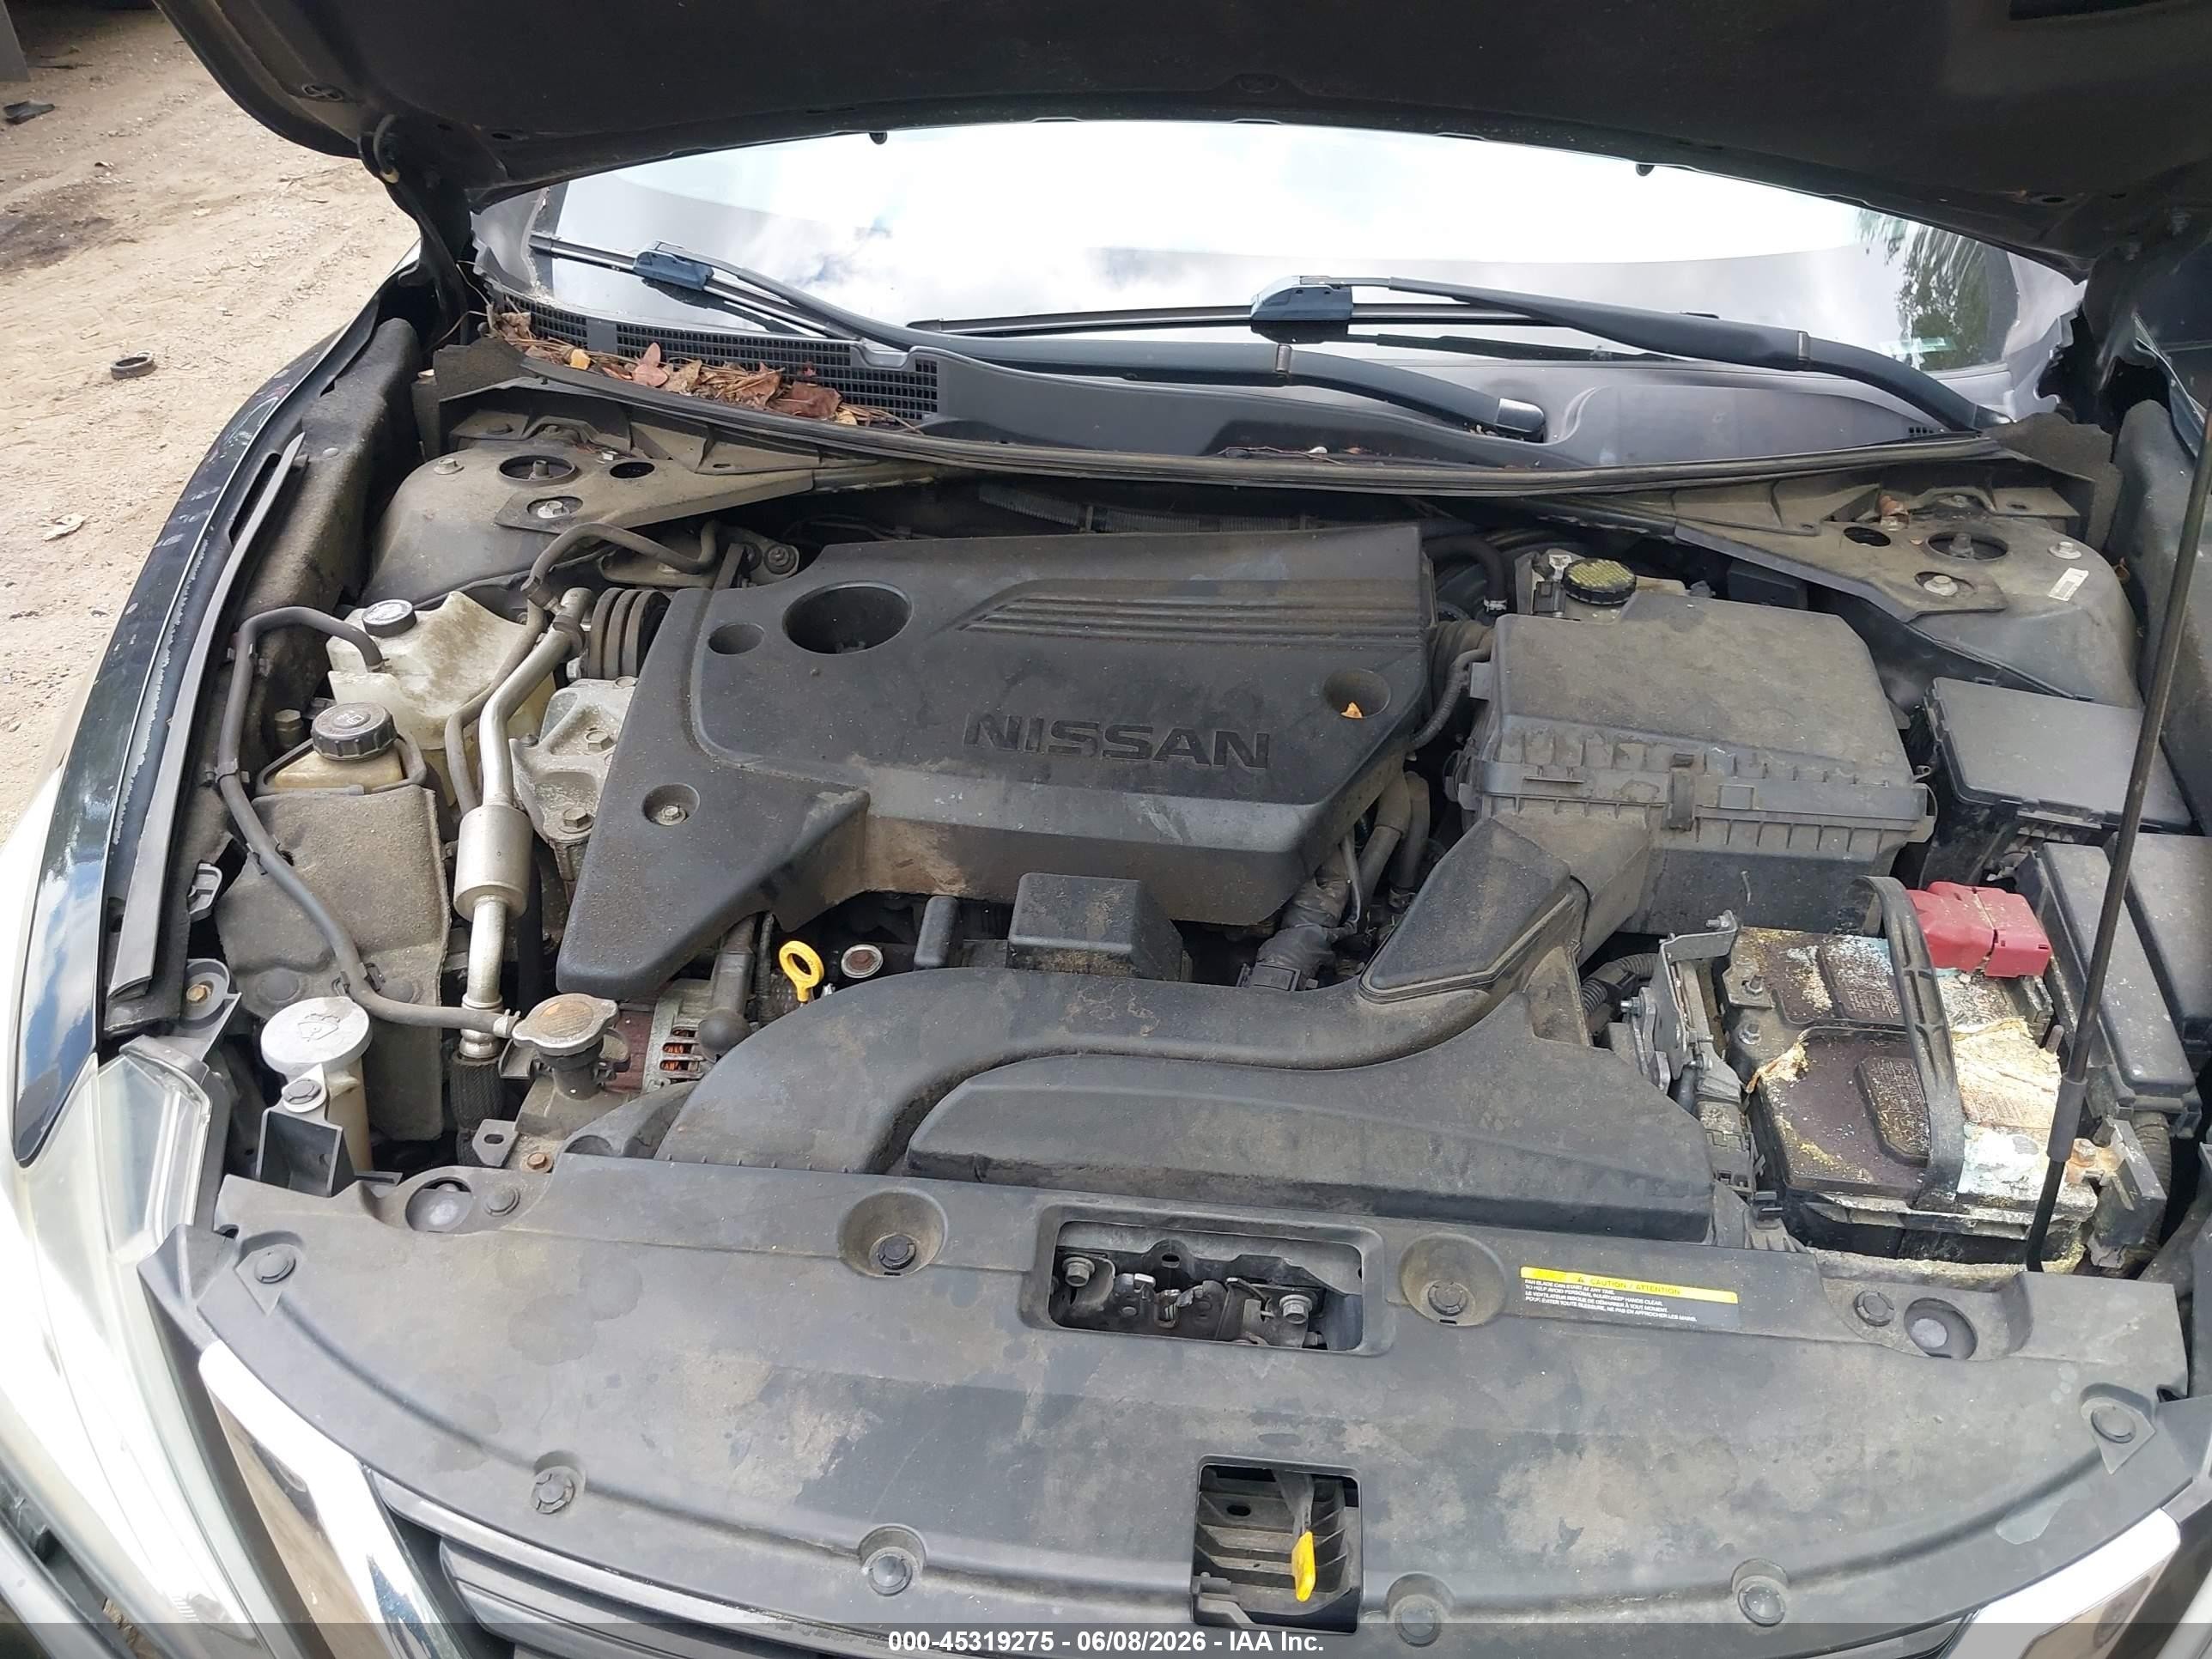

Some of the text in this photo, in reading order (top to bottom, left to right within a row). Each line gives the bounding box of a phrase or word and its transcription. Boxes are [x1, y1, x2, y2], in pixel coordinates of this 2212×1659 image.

[963, 712, 1271, 770] NISSAN
[1590, 1279, 1626, 1288] CAUTION
[1636, 1285, 1680, 1294] ATTENTION
